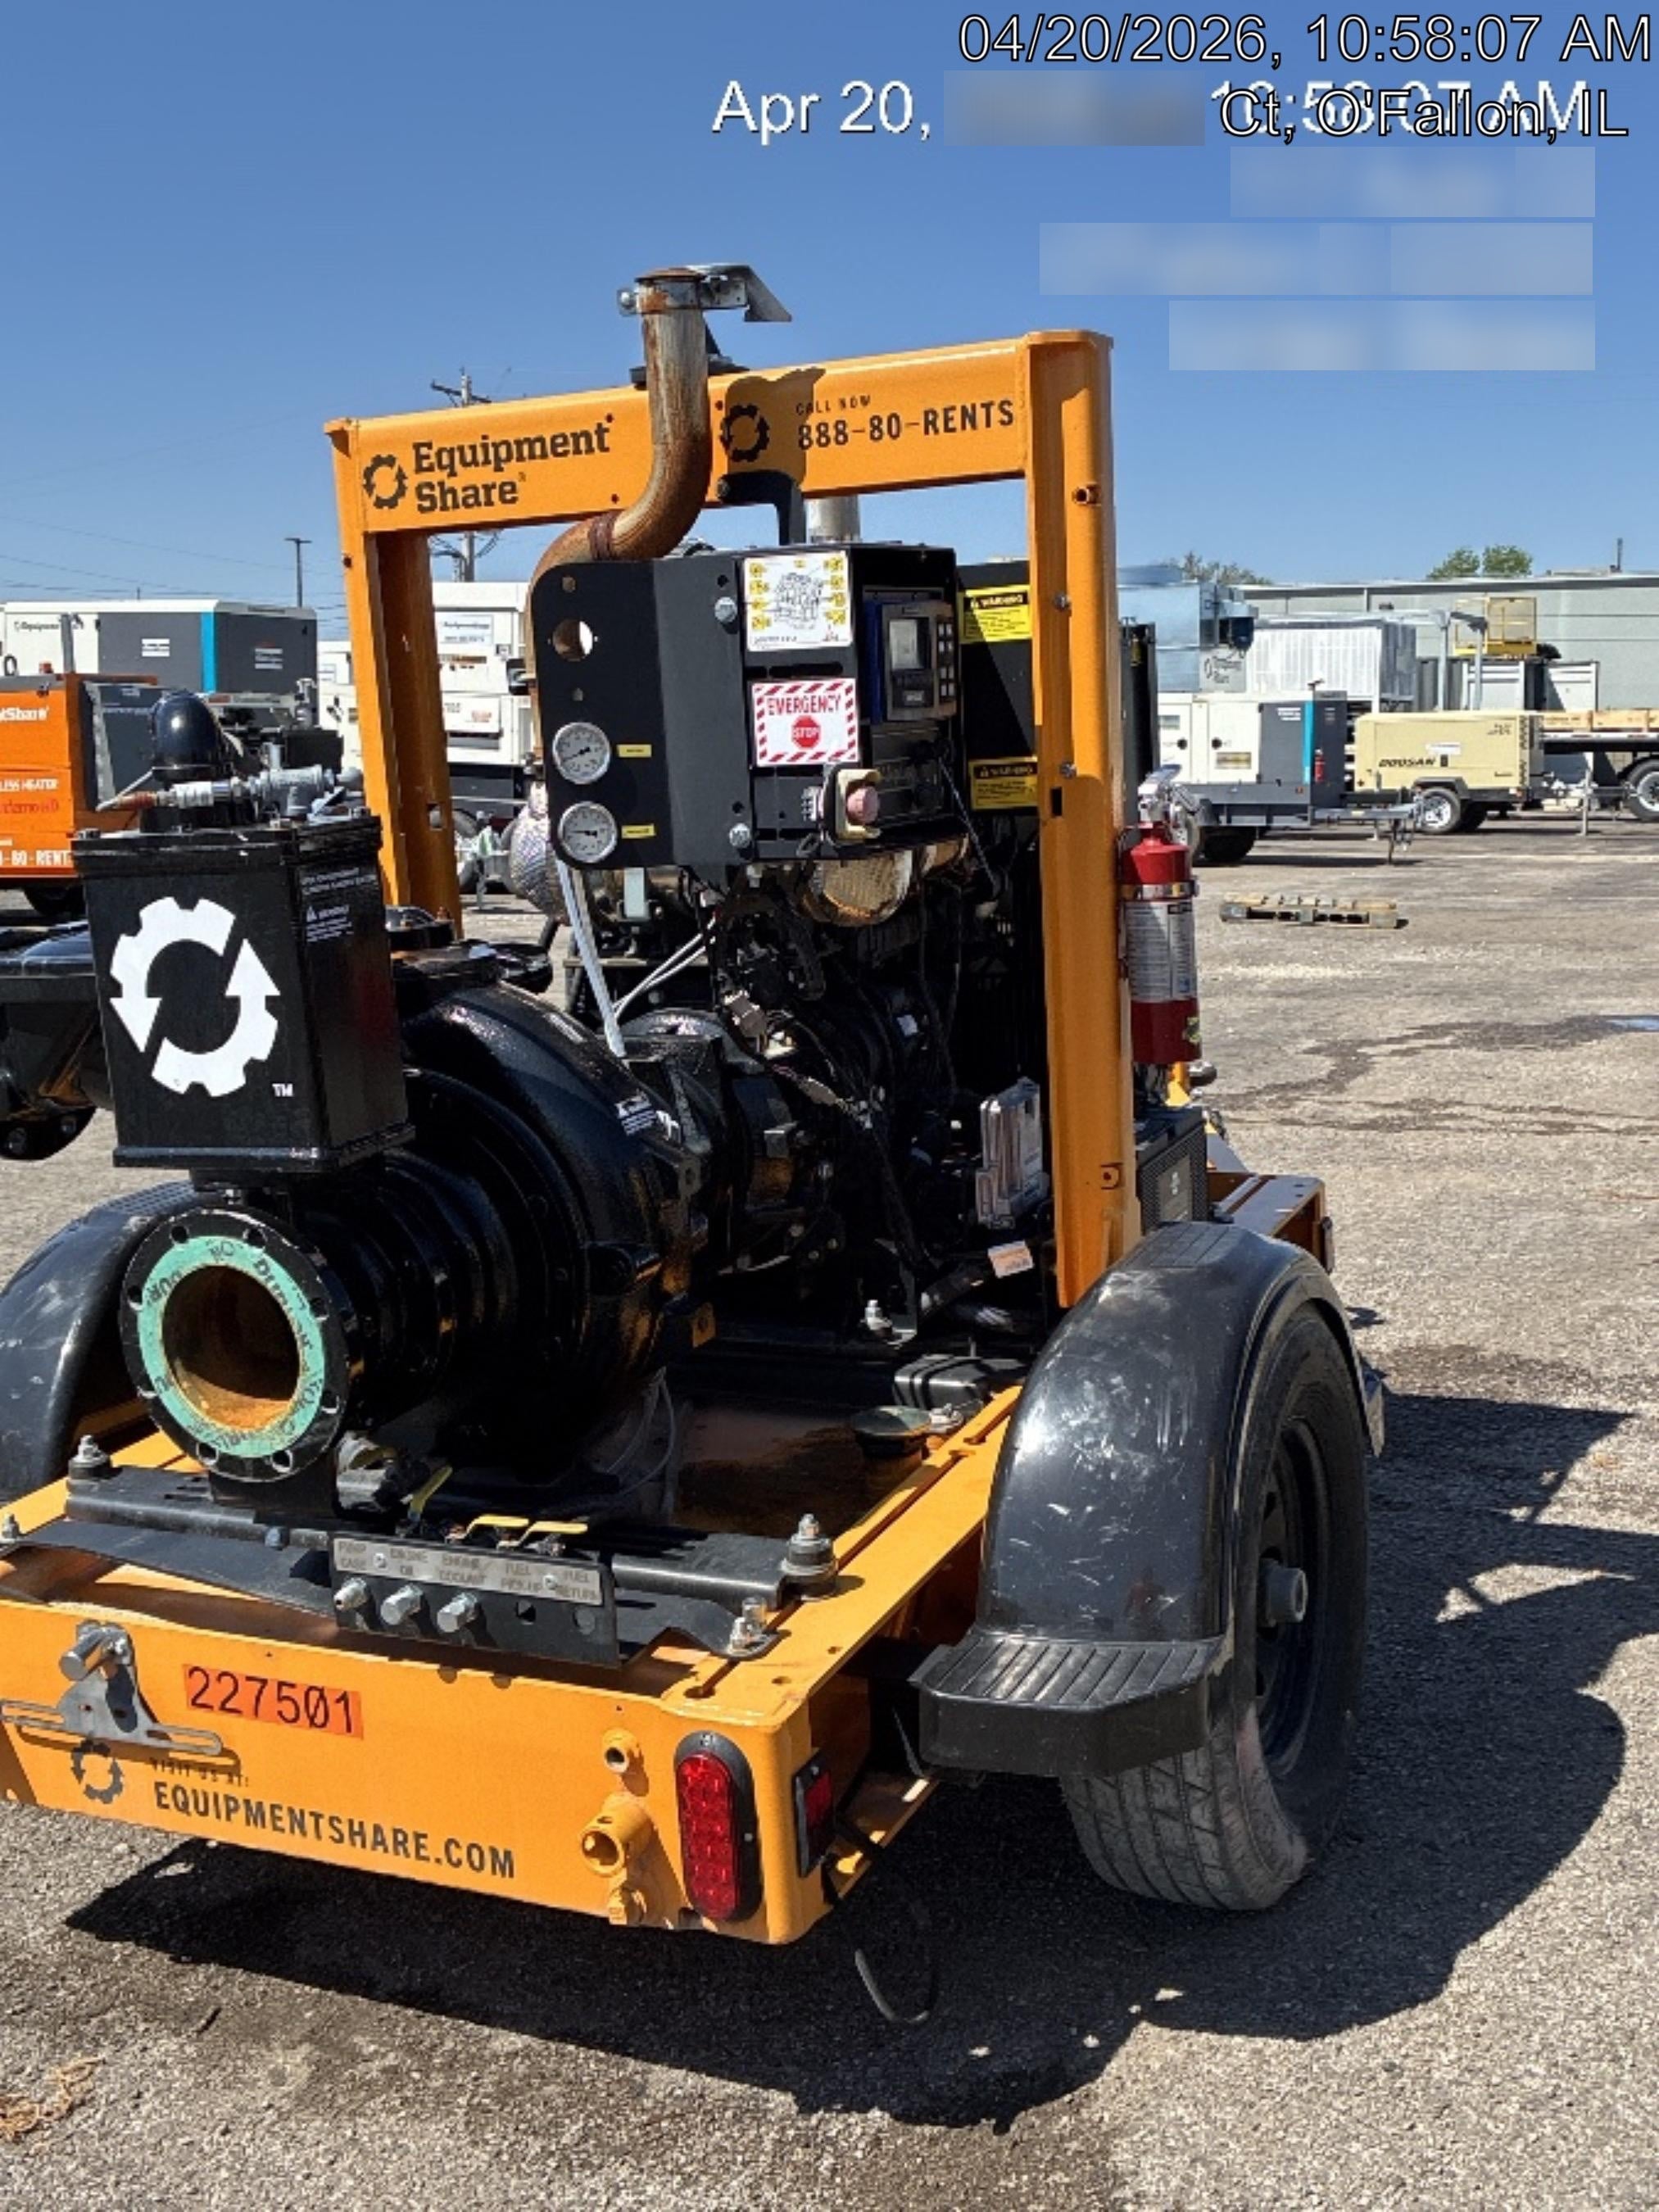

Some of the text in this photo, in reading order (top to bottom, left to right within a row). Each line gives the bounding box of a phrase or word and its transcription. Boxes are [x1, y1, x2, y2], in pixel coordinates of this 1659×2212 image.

[796, 395, 871, 416] CALL NOW
[797, 399, 1015, 451] 888-80-RENTS
[412, 422, 610, 478] Equipment
[767, 693, 842, 716] EMERGENCY
[792, 727, 819, 739] STOP
[1378, 757, 1437, 768] DOOSAN
[272, 1083, 294, 1098] TM
[188, 1666, 353, 1734] 227501
[154, 1780, 516, 1879] EQUIPMENTSHARE.COM
